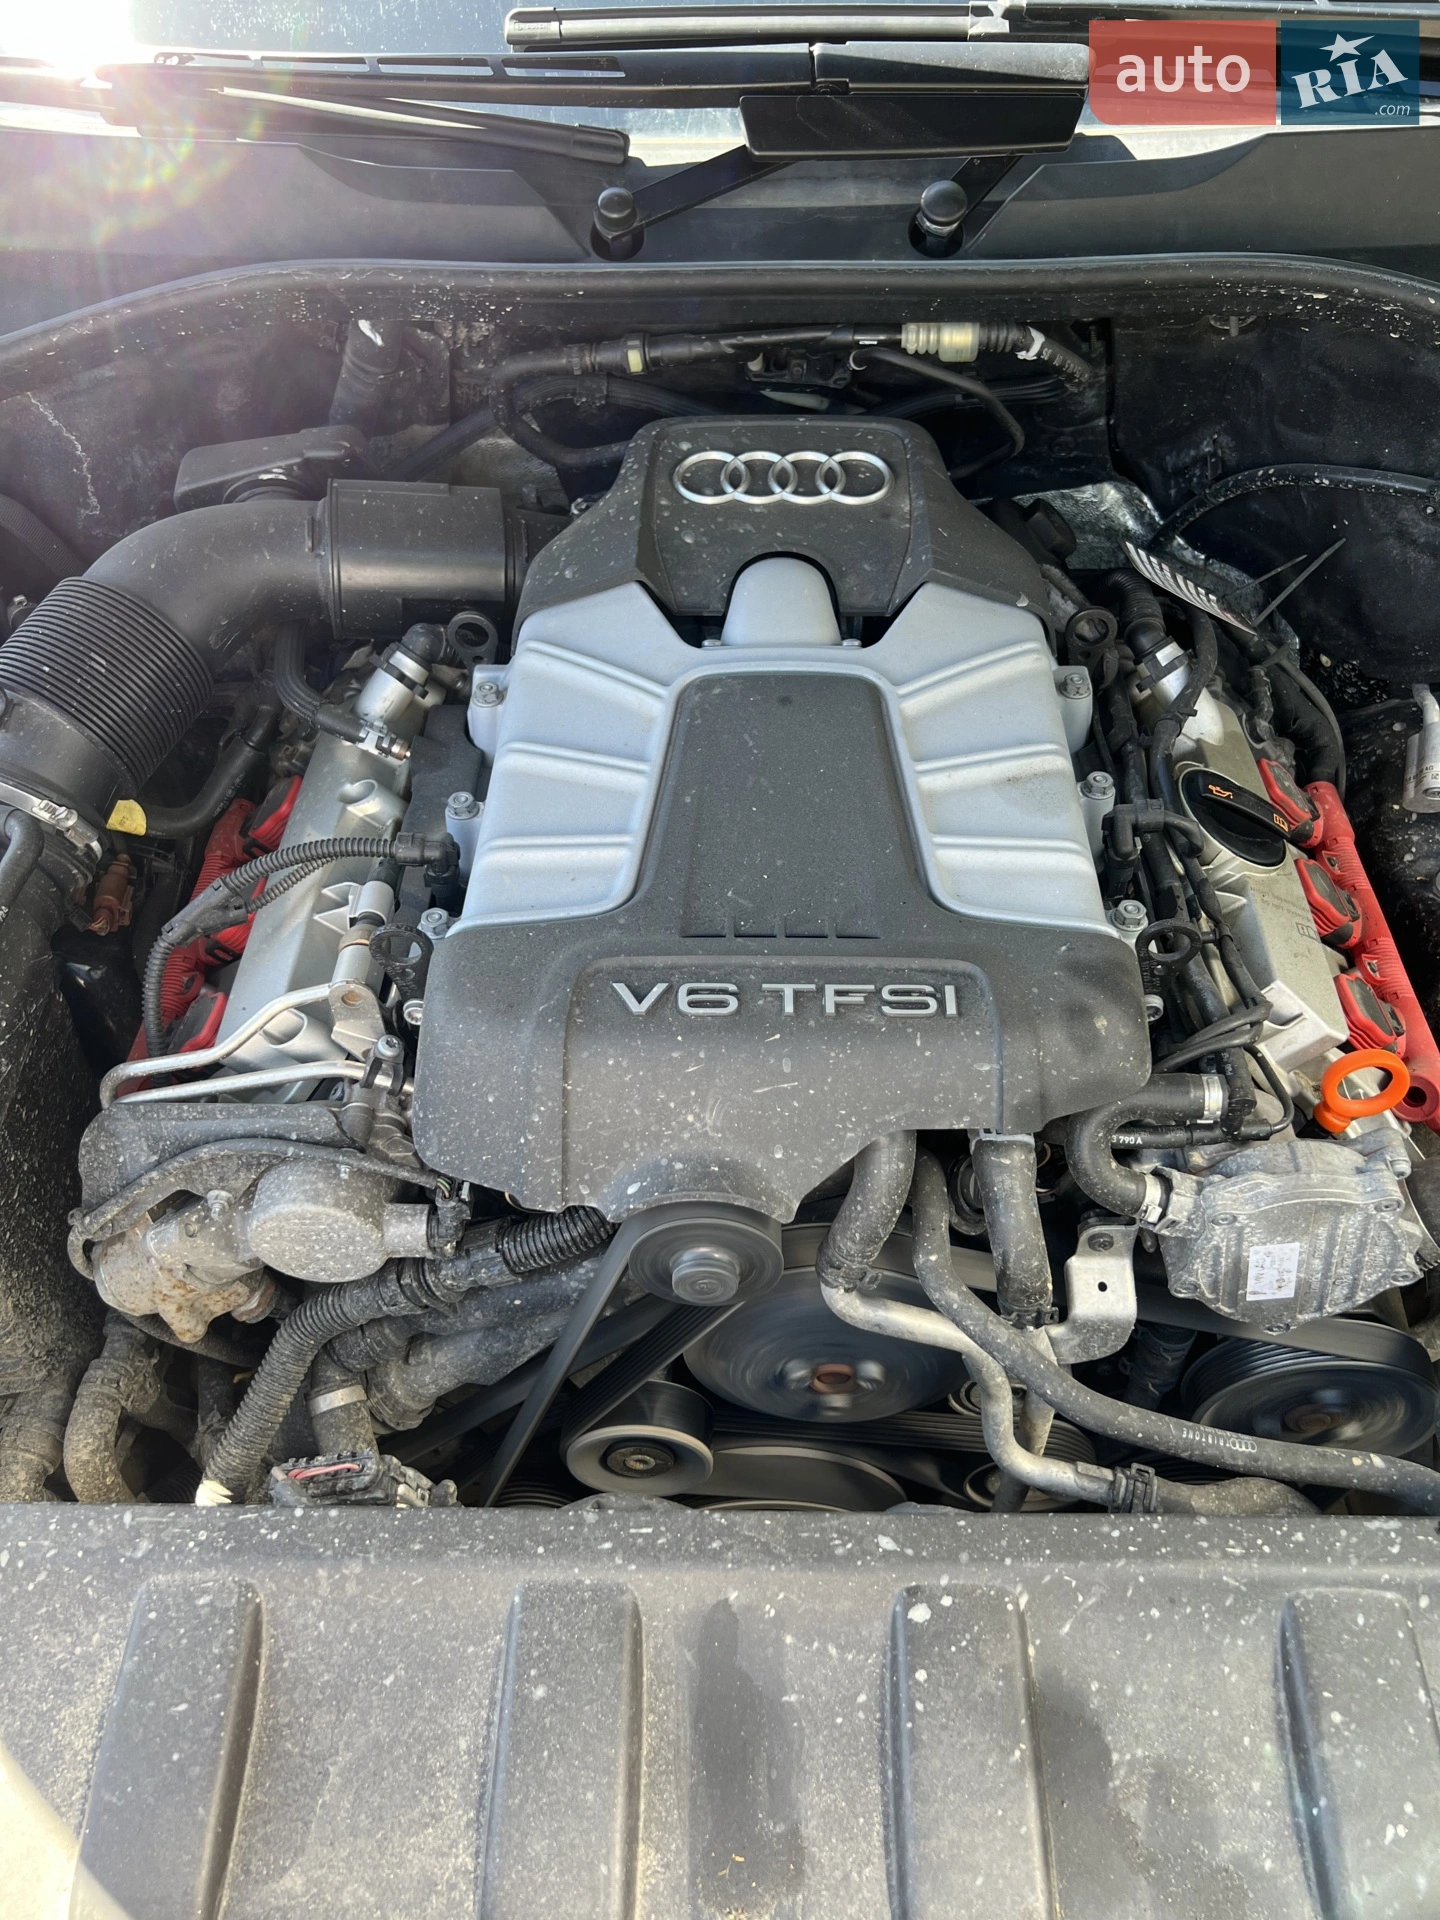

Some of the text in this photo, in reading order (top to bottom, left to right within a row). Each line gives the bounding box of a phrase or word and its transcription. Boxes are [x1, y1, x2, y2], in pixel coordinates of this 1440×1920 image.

[612, 982, 959, 1017] V6 TFSI
[1118, 1135, 1134, 1144] 790
[1136, 1137, 1143, 1145] A
[1182, 1427, 1231, 1447] TRISTONE
